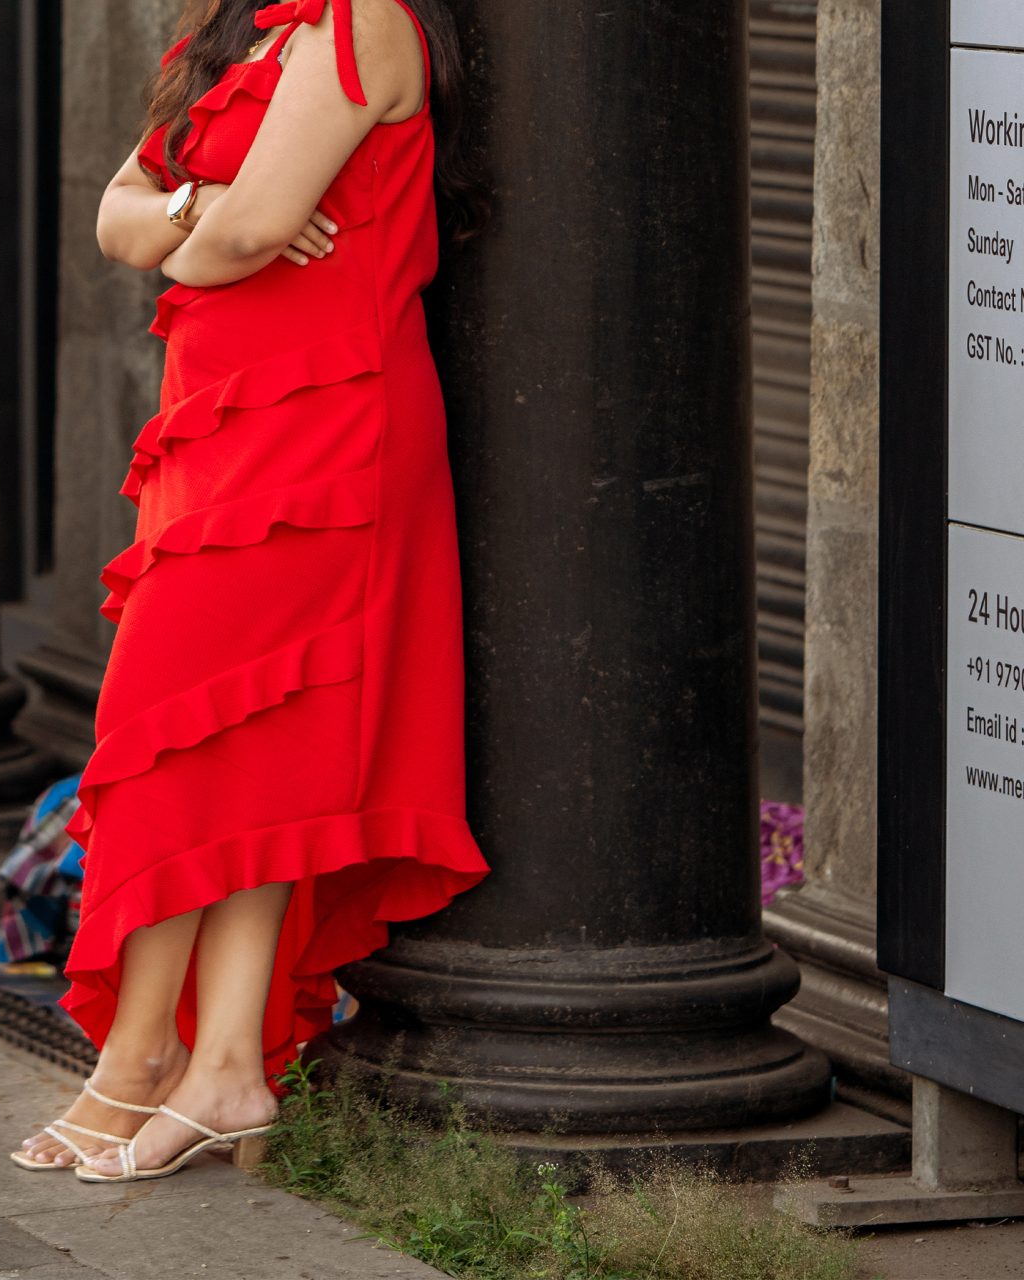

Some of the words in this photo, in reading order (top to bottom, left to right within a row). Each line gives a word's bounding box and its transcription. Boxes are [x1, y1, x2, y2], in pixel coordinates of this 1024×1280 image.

[968, 174, 995, 202] Mon
[967, 227, 1014, 265] Sunday
[967, 280, 1016, 312] Contact
[967, 332, 992, 361] GST
[996, 336, 1017, 366] No.
[968, 588, 990, 626] 24
[967, 656, 990, 683] +91
[967, 706, 1001, 740] Email
[1005, 716, 1017, 744] id
[966, 765, 1024, 800] www.me
